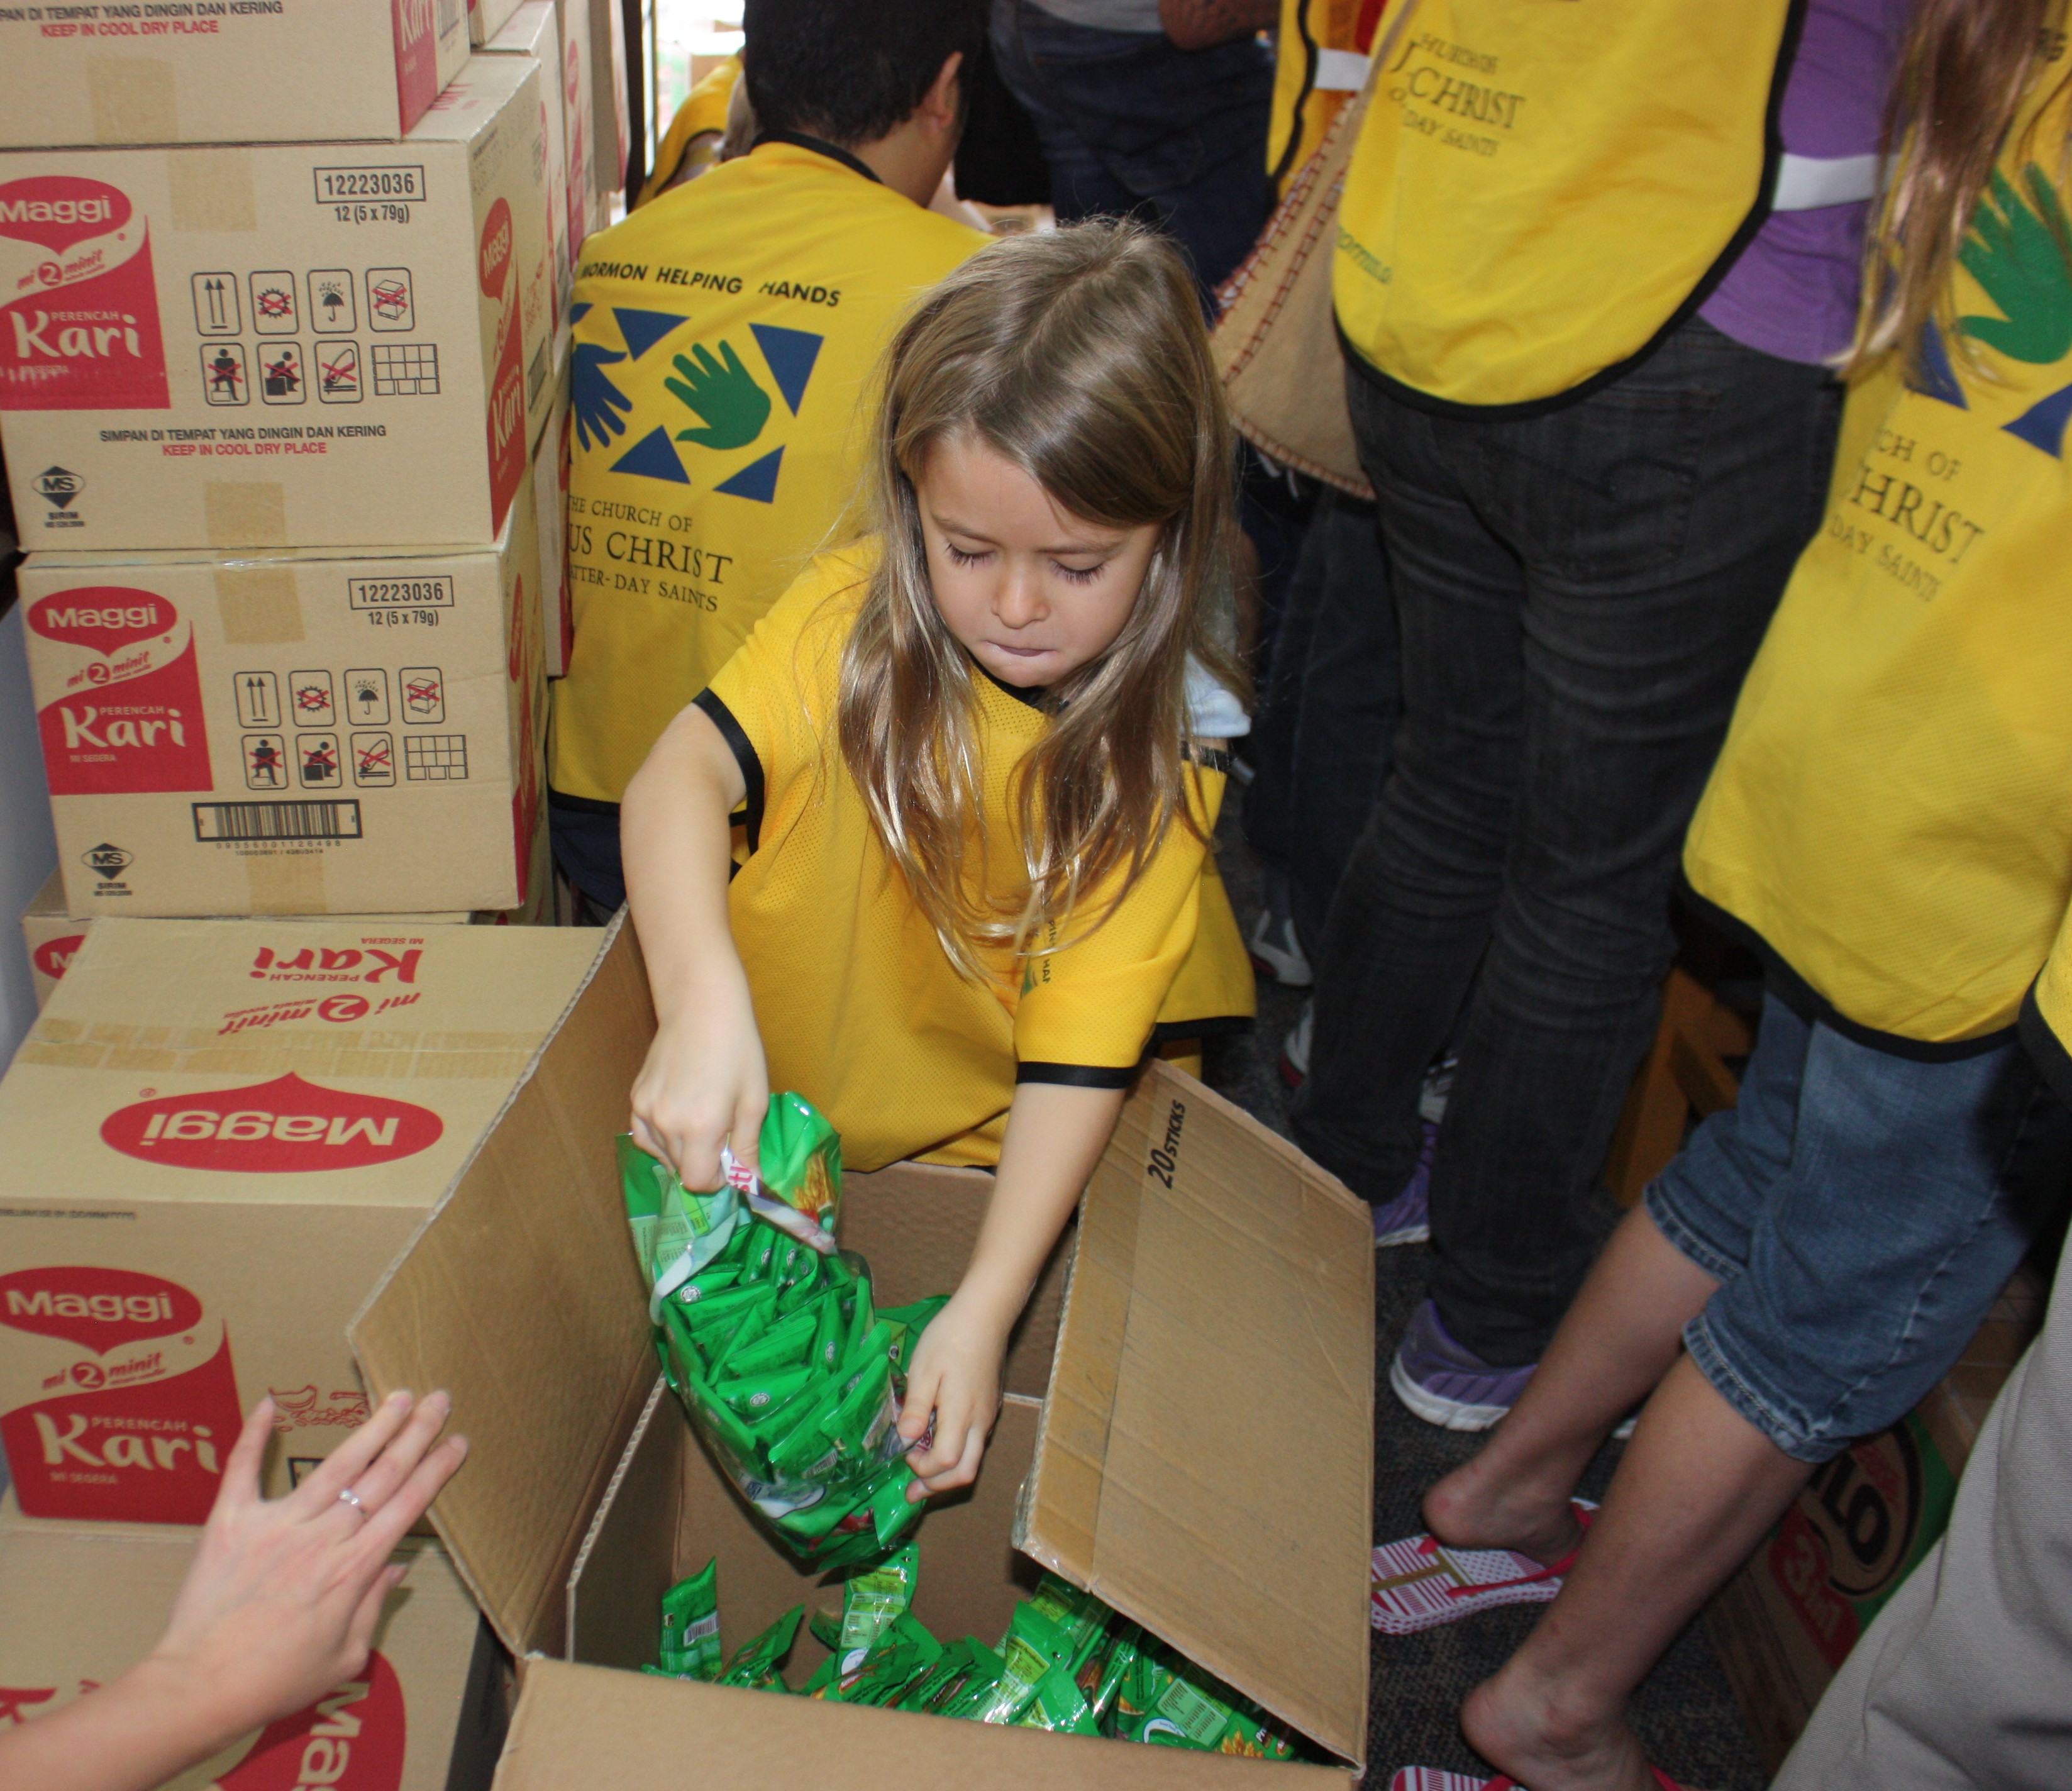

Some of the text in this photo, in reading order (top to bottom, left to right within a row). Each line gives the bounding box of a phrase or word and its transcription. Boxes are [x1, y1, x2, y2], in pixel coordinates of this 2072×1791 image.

[28, 8, 43, 19] DI
[46, 6, 99, 19] TEMPAT
[102, 4, 141, 18] YANG
[145, 3, 193, 17] DINGIN
[197, 2, 227, 16] DAN
[229, 1, 283, 14] KERING
[40, 19, 219, 38] KEEP IN COOL DRY PLACE
[1409, 67, 1526, 130] CHRIST
[324, 174, 414, 196] 12223036
[0, 196, 112, 224] Maggi
[335, 204, 410, 225] 12 (5 x 79g)
[42, 263, 61, 284] 2
[655, 266, 744, 294] HELPING
[758, 281, 841, 307] HANDS
[51, 311, 119, 321] PERENCAH
[9, 310, 142, 358] Kari
[100, 425, 386, 441] SIMPAN DI TEMPAT YANG DINGIN DAN KERING
[162, 442, 326, 456] KEEP IN COOL DRY PLACE
[42, 477, 74, 491] MS
[592, 501, 662, 527] CHURCH
[668, 514, 692, 533] OF
[606, 531, 733, 585] CHRIST
[358, 582, 443, 602] 12223036
[659, 581, 718, 613] SAINTS
[46, 604, 157, 629] Maggi
[368, 610, 439, 628] 12 (5 x 79g)
[90, 665, 107, 682] 2
[99, 706, 165, 716] PERENCAH
[60, 706, 186, 748] Kari
[91, 852, 123, 865] MS
[250, 946, 423, 984] Kari
[270, 973, 359, 982] PERENCAH
[374, 992, 421, 1015] mi
[218, 1007, 312, 1036] minit
[139, 1111, 400, 1146] Maggi
[1148, 1099, 1185, 1190] 20 STICKS
[6, 1290, 172, 1322] Maggi
[75, 1365, 101, 1386] 2
[92, 1417, 187, 1432] PERENCAH
[32, 1412, 219, 1474] Kari
[289, 1682, 370, 1791] Ma
